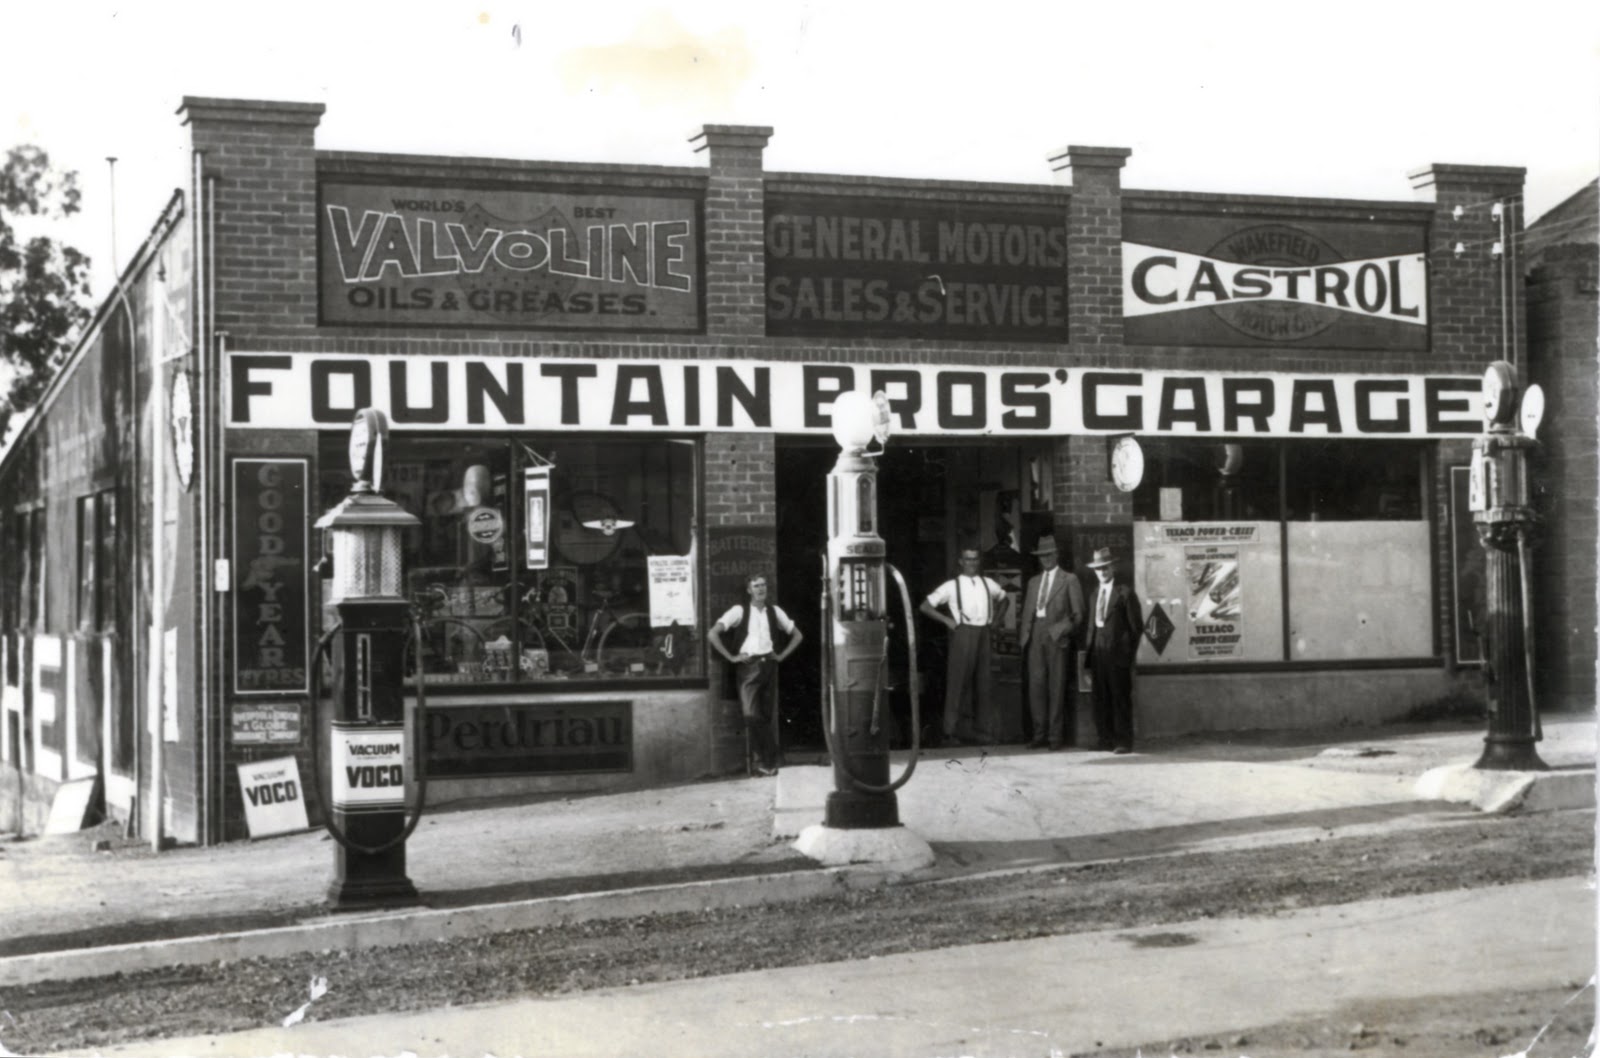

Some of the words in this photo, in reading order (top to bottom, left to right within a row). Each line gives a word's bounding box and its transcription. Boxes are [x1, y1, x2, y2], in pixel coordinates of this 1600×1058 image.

[392, 197, 466, 215] WORLD'S
[573, 205, 617, 220] BEST
[326, 204, 691, 293] VALVOLINE
[766, 214, 930, 263] GENERAL
[938, 220, 1065, 268] MOTORS
[1228, 232, 1321, 263] WAKEFIELD
[347, 286, 434, 312] OILS
[441, 291, 461, 312] &
[1130, 255, 1420, 319] CASTROL
[766, 276, 889, 321] SALES
[892, 290, 918, 323] &
[918, 281, 1065, 327] SERVICE
[229, 354, 772, 427] FOUNTAIN
[1082, 371, 1484, 434] GARAGE
[710, 535, 776, 556] BATTERIES
[1165, 527, 1196, 537] TEXACO
[257, 463, 286, 667] GOODYEAR
[1195, 624, 1235, 635] TEXACO
[238, 668, 305, 687] TYRES
[425, 709, 625, 753] Perdriau
[349, 743, 401, 756] VACUUM
[346, 764, 404, 789] VOCO
[245, 780, 298, 807] VOCO
